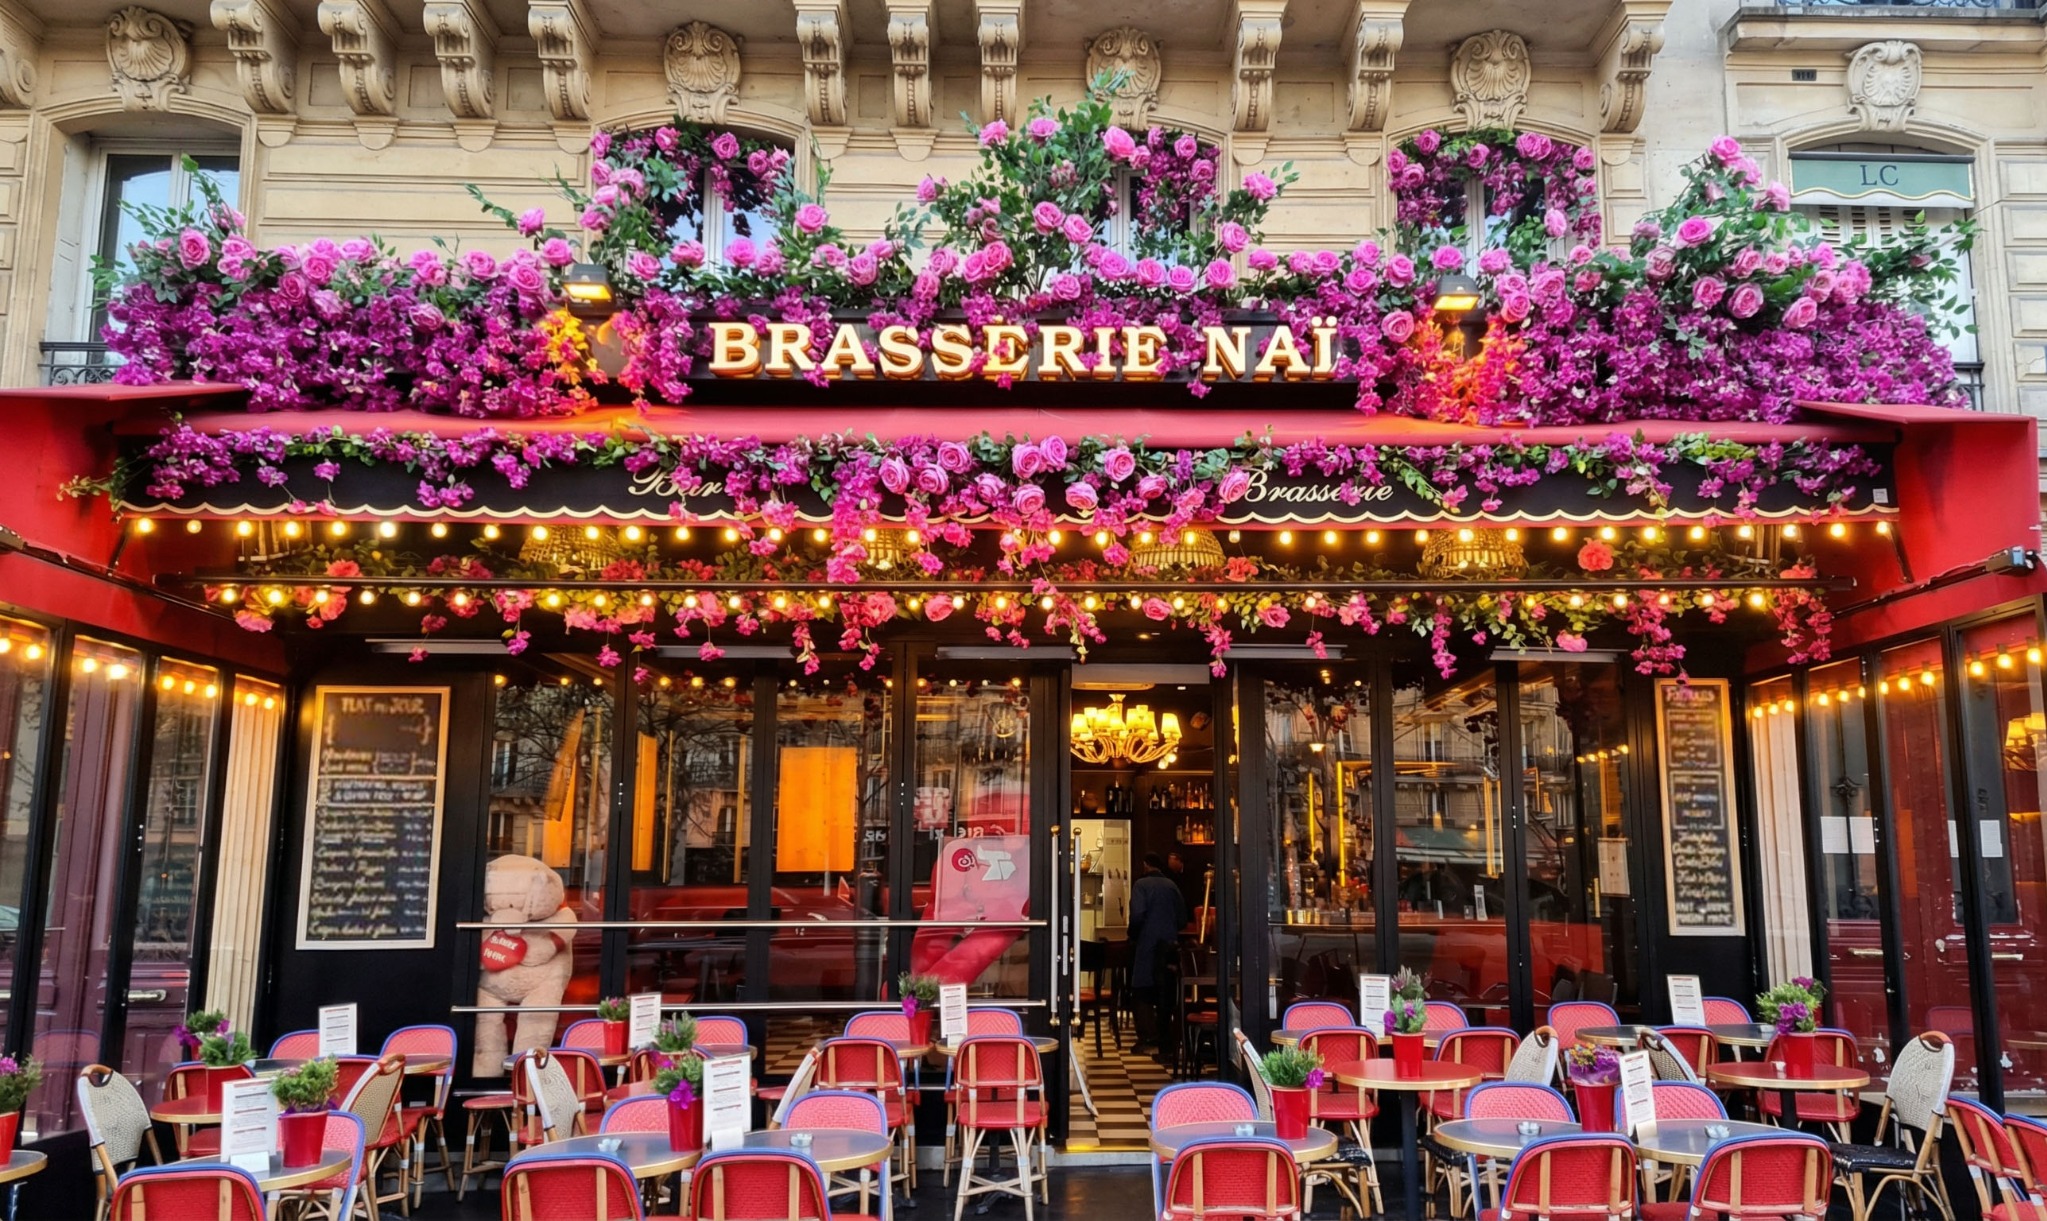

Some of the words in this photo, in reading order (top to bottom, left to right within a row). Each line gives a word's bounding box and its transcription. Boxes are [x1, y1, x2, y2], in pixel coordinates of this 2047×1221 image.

[1859, 164, 1899, 187] LC
[708, 321, 1168, 380] BRASSERIE
[1202, 315, 1338, 381] NAÏ
